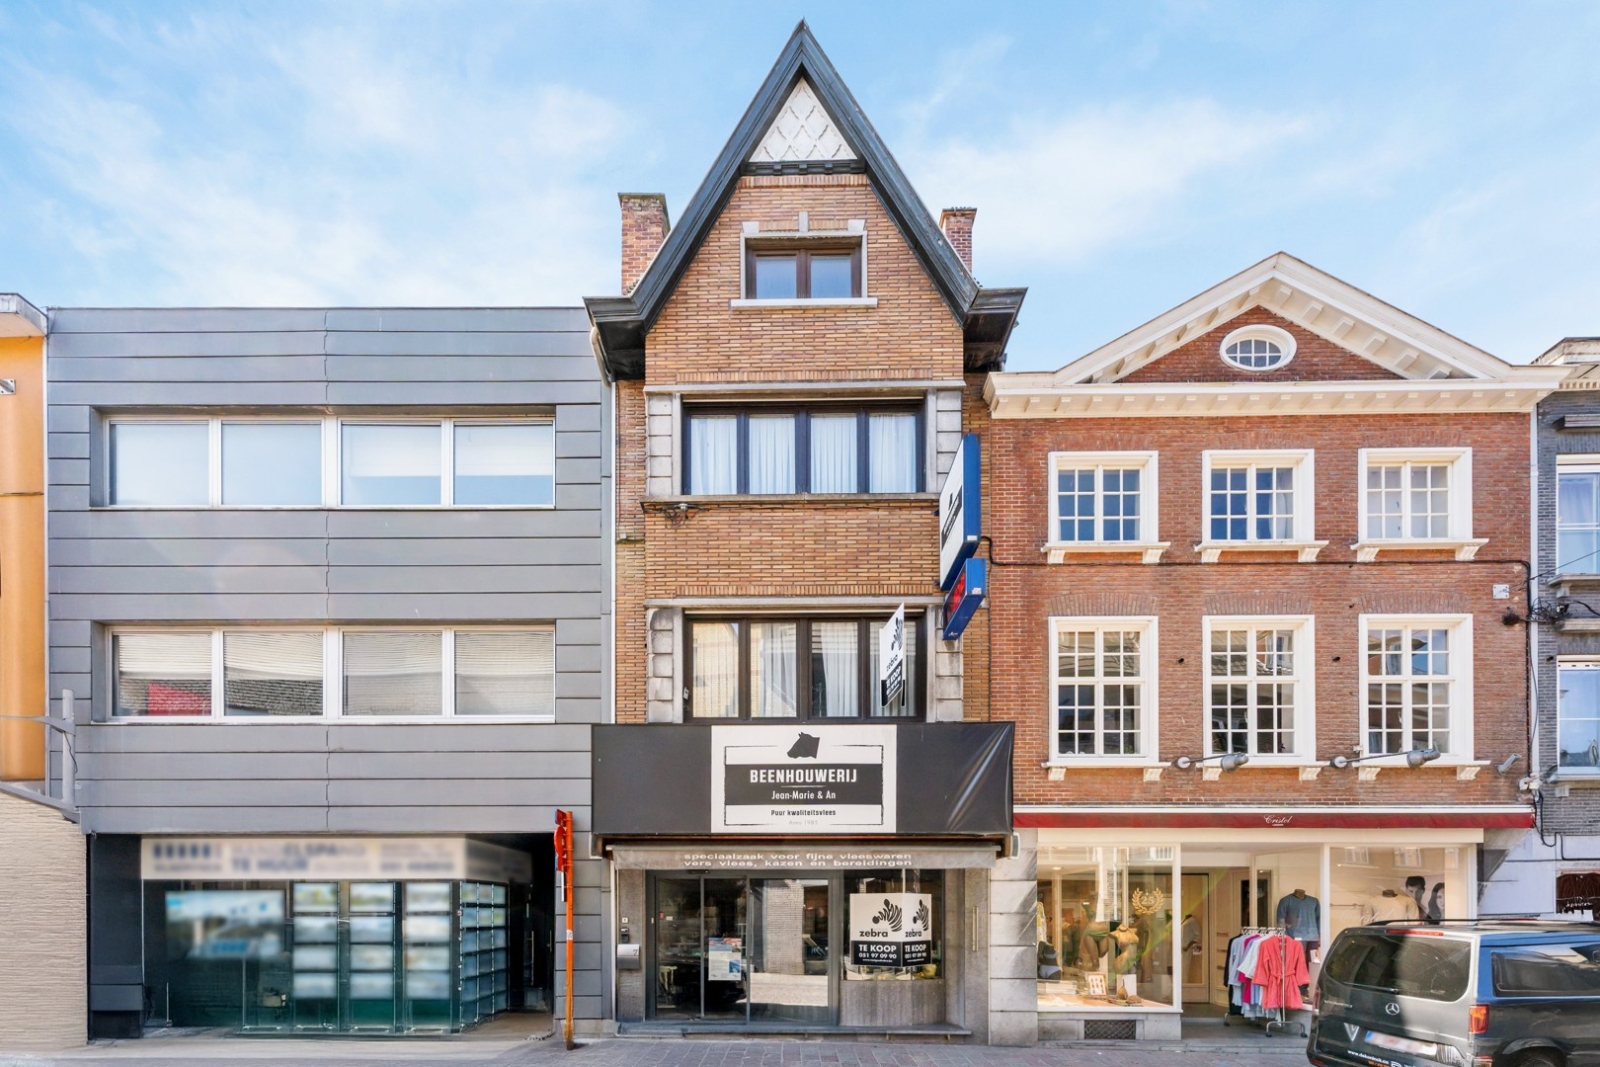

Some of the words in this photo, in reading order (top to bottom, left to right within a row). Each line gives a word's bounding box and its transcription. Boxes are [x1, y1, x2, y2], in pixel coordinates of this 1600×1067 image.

[750, 769, 857, 783] BEENHOUWERIJ
[771, 790, 815, 800] Jean-Marie
[817, 790, 823, 800] &
[825, 790, 836, 799] An
[684, 853, 764, 861] speciaalzaak
[806, 853, 833, 861] fijne
[1141, 896, 1154, 905] 25
[859, 928, 888, 937] zebra
[905, 929, 922, 938] zebra
[859, 944, 868, 952] TE
[870, 944, 897, 953] KOOP
[904, 945, 911, 953] TE
[911, 944, 927, 952] KOOP
